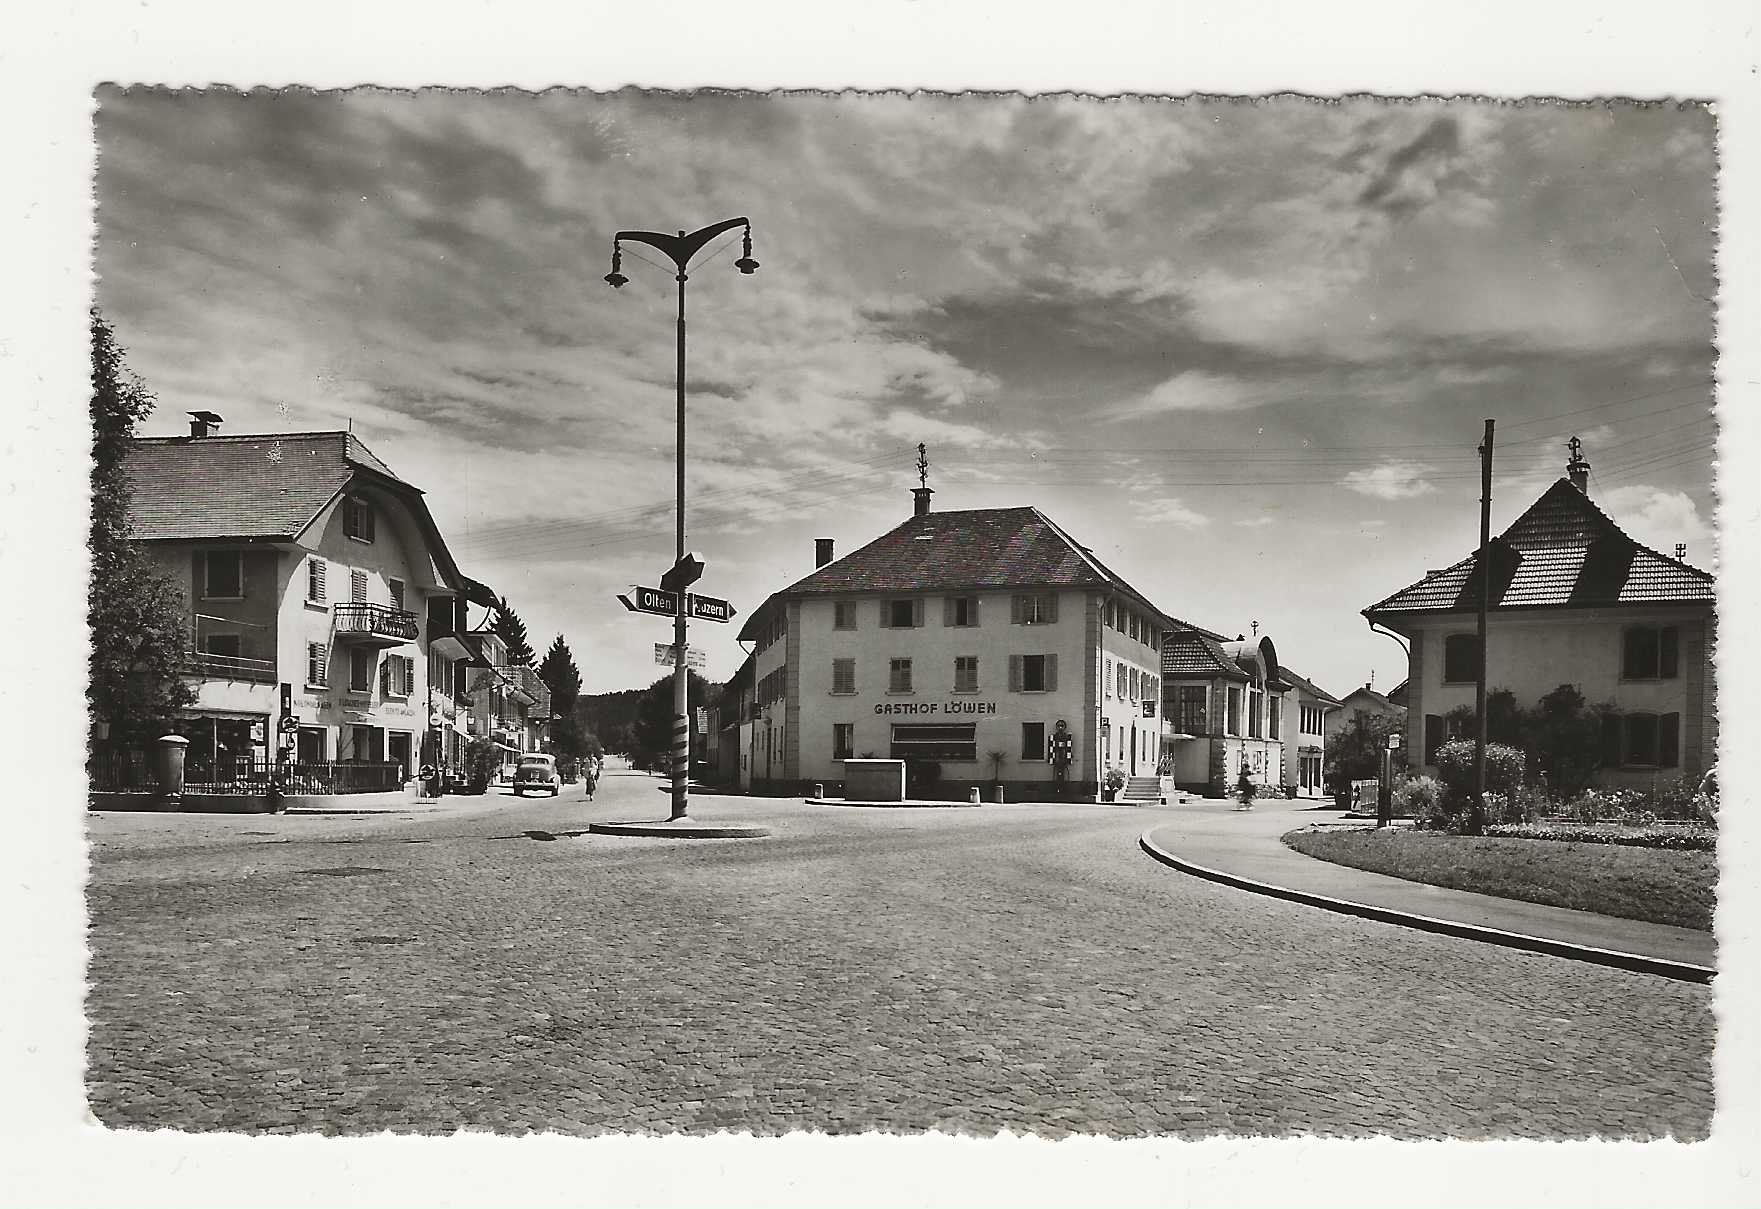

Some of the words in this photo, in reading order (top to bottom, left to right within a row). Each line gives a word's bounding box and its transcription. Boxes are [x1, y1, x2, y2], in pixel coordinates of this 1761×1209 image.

[644, 592, 671, 609] Olten
[873, 703, 938, 715] GASTHOF
[944, 701, 997, 714] LÖWEN
